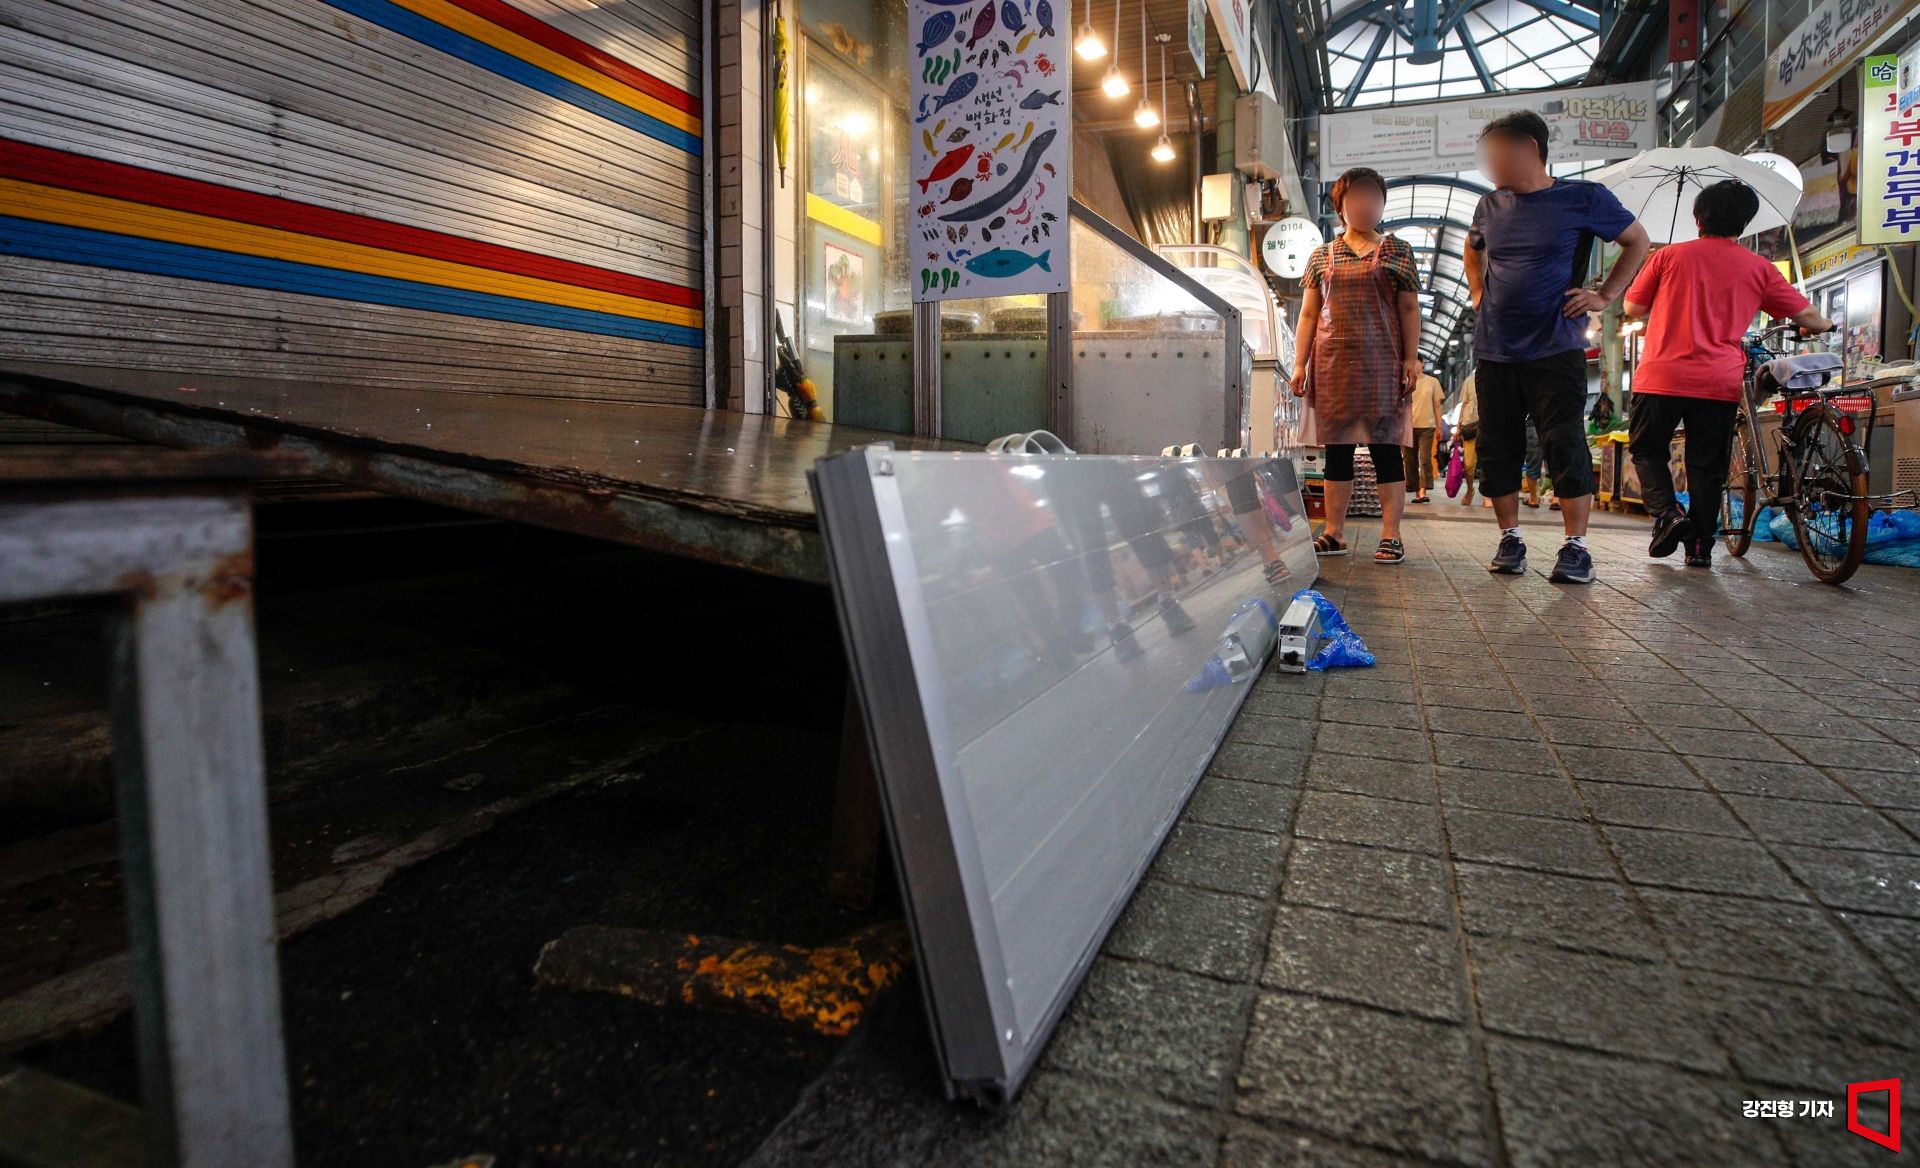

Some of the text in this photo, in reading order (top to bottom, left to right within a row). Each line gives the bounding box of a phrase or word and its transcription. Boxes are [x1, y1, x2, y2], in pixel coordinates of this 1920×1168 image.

[974, 87, 1004, 107] 생선
[965, 106, 1012, 131] 백화점
[1280, 223, 1303, 232] D104
